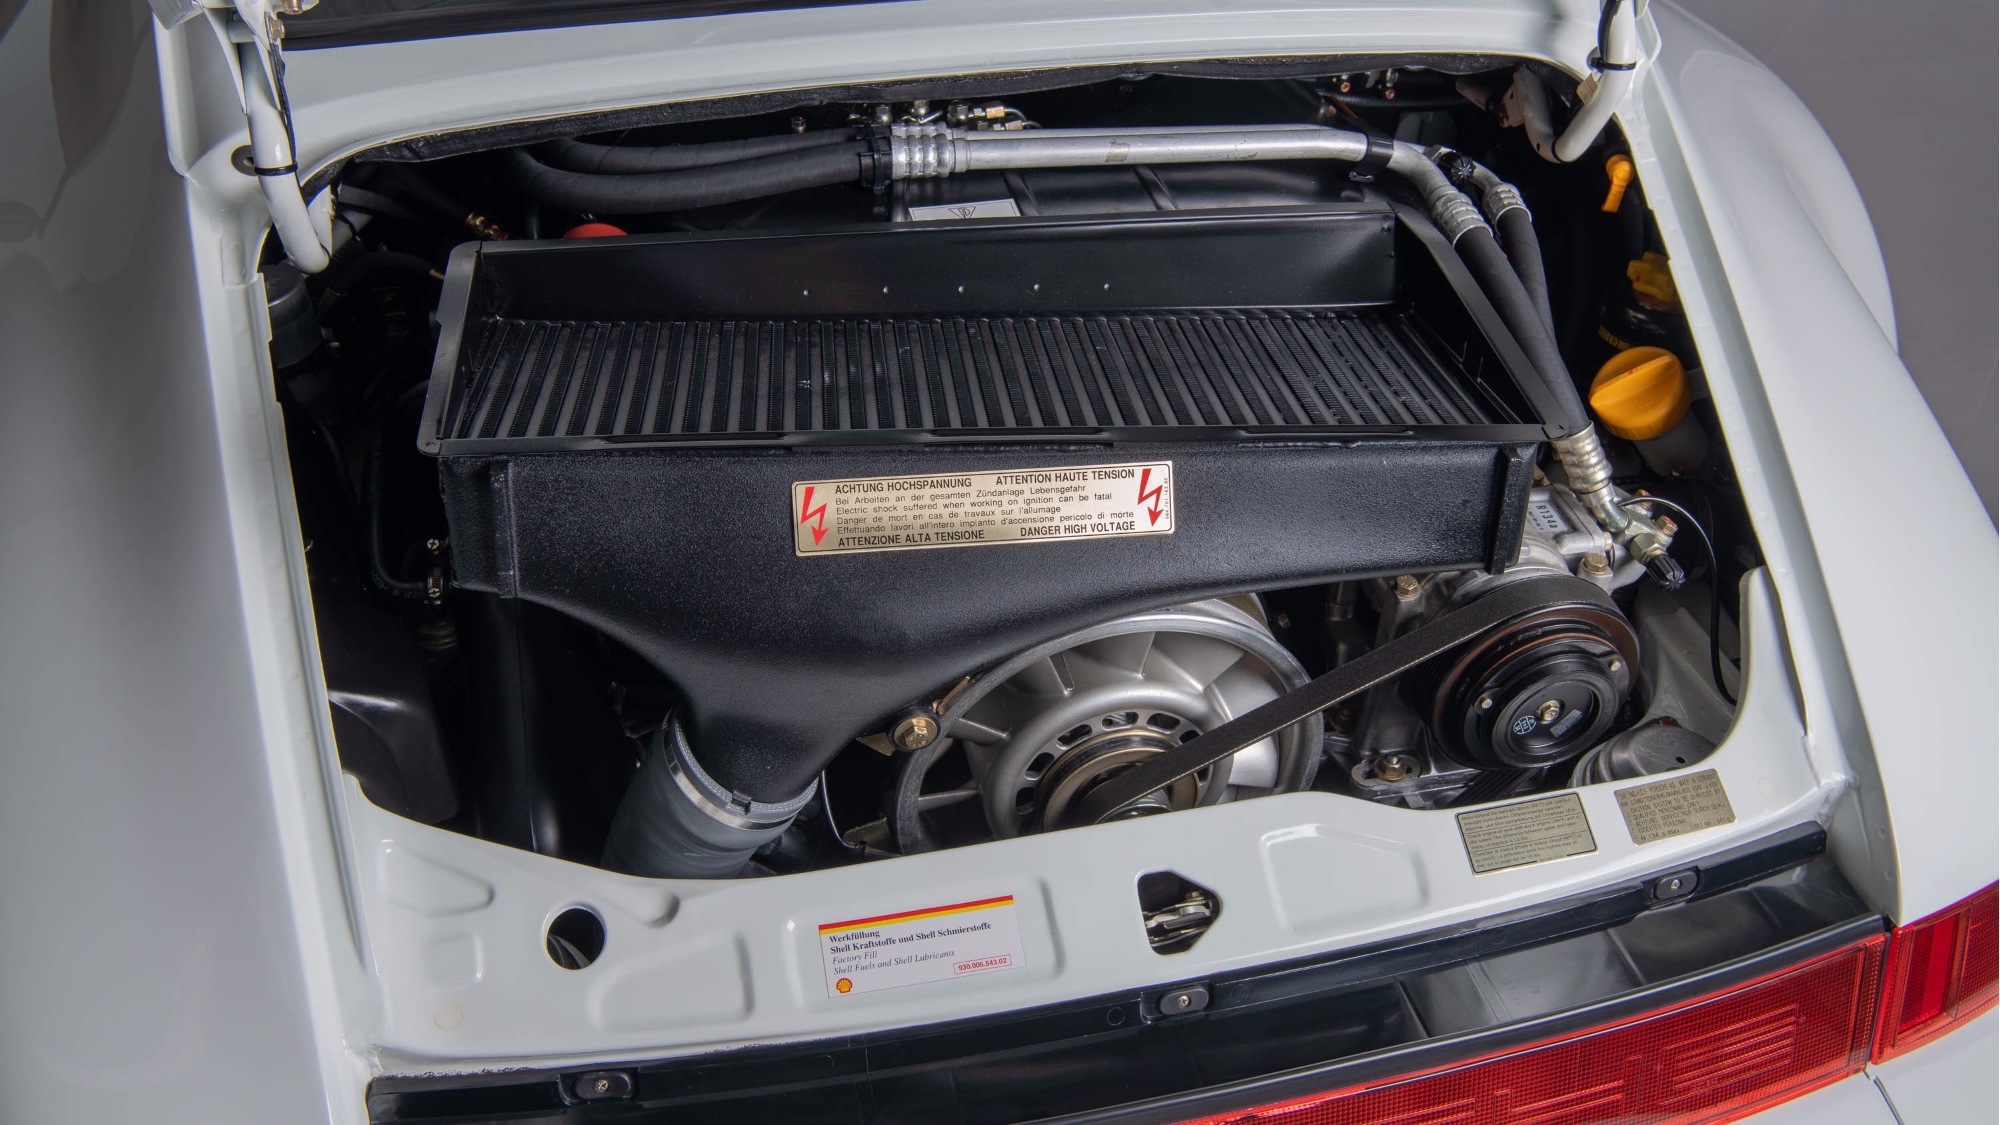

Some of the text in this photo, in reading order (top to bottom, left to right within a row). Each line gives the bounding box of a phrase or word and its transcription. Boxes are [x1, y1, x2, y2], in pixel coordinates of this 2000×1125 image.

[996, 469, 1135, 485] ATTENTION HAUTE TENSION
[835, 478, 972, 494] ACHTUNG HOCHSPANNUNG
[855, 496, 890, 504] Arbeiten
[911, 494, 924, 502] der
[930, 492, 971, 502] gesamten
[976, 488, 1025, 498] Zündanlage
[1030, 485, 1086, 496] Lebensgefahr
[836, 506, 868, 514] Electric
[904, 503, 938, 511] suffered
[970, 499, 1003, 508] working
[1024, 496, 1054, 506] ignition
[1094, 492, 1112, 500] fatal
[837, 517, 867, 526] Danger
[873, 515, 883, 523] de
[889, 514, 907, 522] mort
[964, 509, 995, 517] travaux
[1019, 506, 1061, 515] l'allumage
[838, 524, 886, 534] Effettuando
[920, 521, 955, 529] all'intero
[960, 519, 995, 529] impianto
[1001, 516, 1054, 525] d'accensione
[1060, 514, 1092, 523] pericolo
[1536, 505, 1558, 528] R134a
[1020, 521, 1135, 537] DANGER HIGH VOLTAGE
[838, 530, 984, 547] ATTENZIONE ALTA TENSIONE
[1653, 800, 1672, 808] SYSTEM
[830, 930, 880, 943] Werkfüllung
[830, 922, 992, 954] Shell Kraftstoffe und Shell Schmierstoffe
[832, 951, 878, 965] Factory Fill
[834, 950, 955, 975] Shell Fuels and Shell Lubricants
[958, 957, 1007, 971] 930.006.543.02
